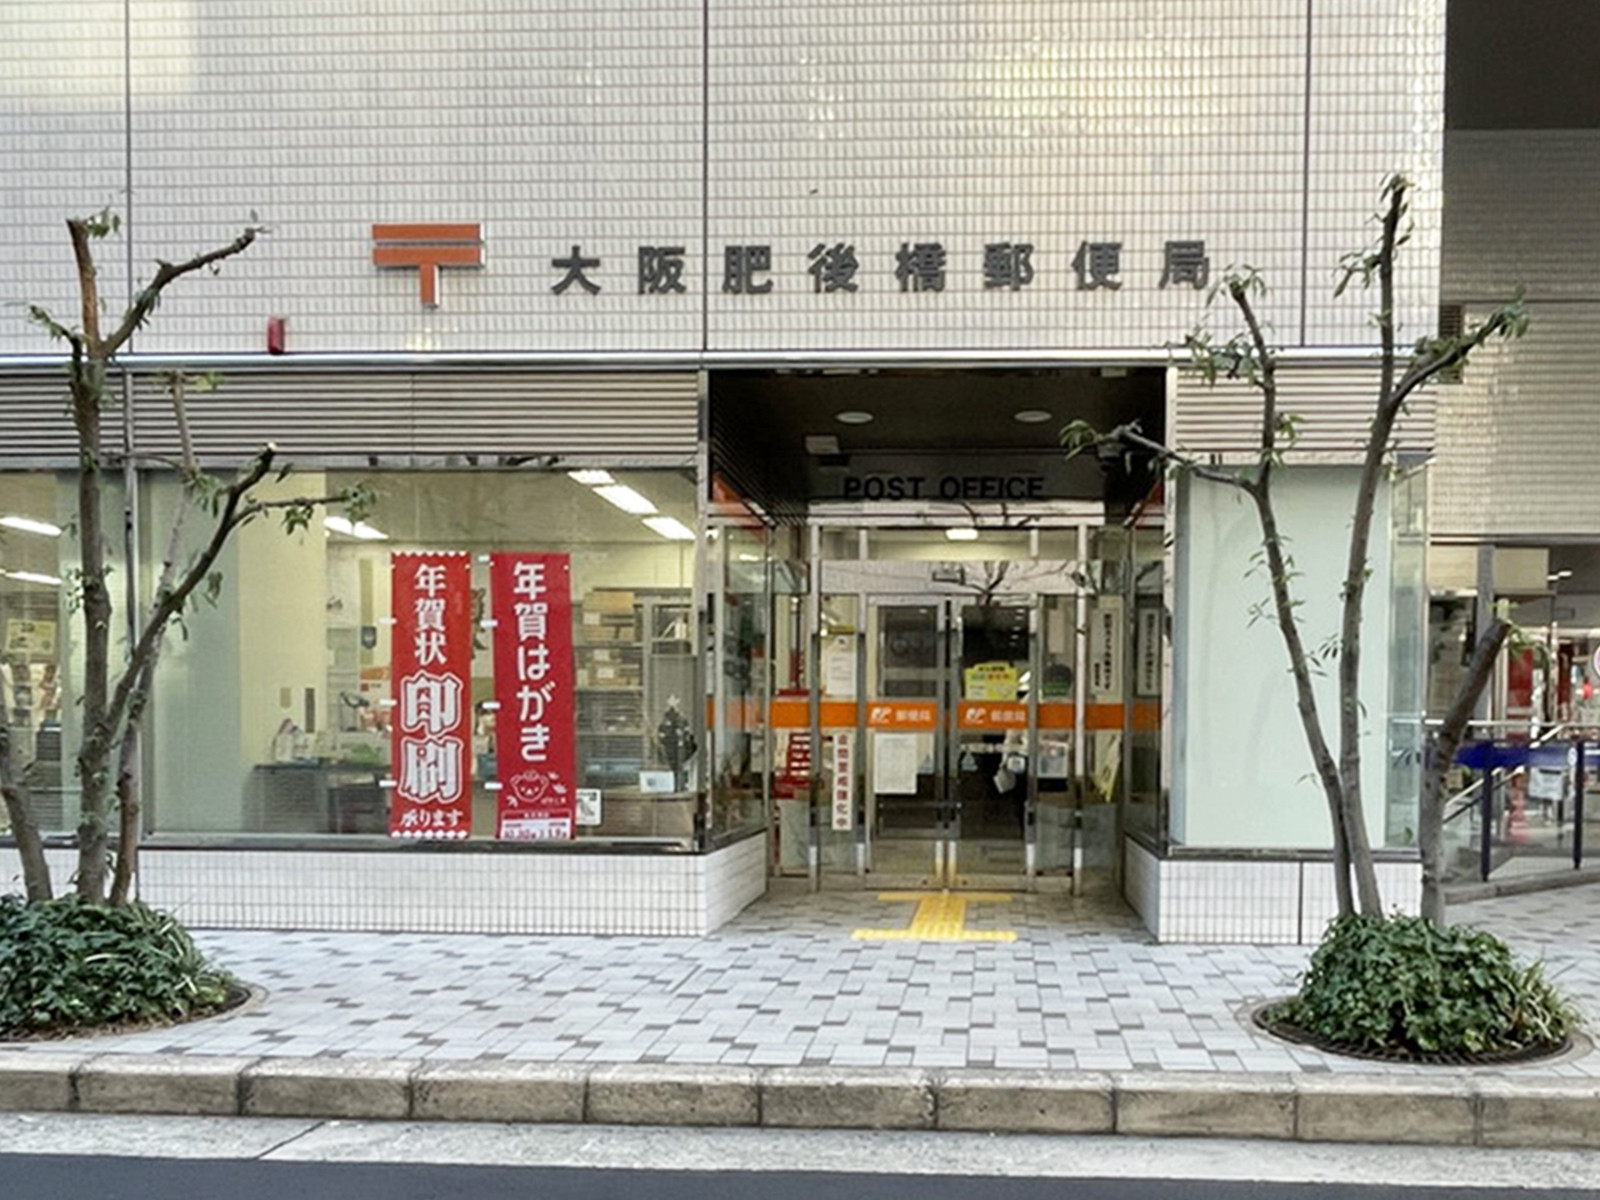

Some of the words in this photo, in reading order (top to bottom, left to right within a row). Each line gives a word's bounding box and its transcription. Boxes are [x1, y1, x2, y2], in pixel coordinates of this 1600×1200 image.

[551, 240, 1210, 295] 大阪肥後橋郵便局
[843, 477, 925, 499] POST
[939, 477, 1044, 499] OFFICE
[414, 563, 447, 666] 年賀状
[513, 561, 555, 762] 年賀はがき
[400, 670, 463, 804] 印刷
[399, 809, 463, 828] 承ります
